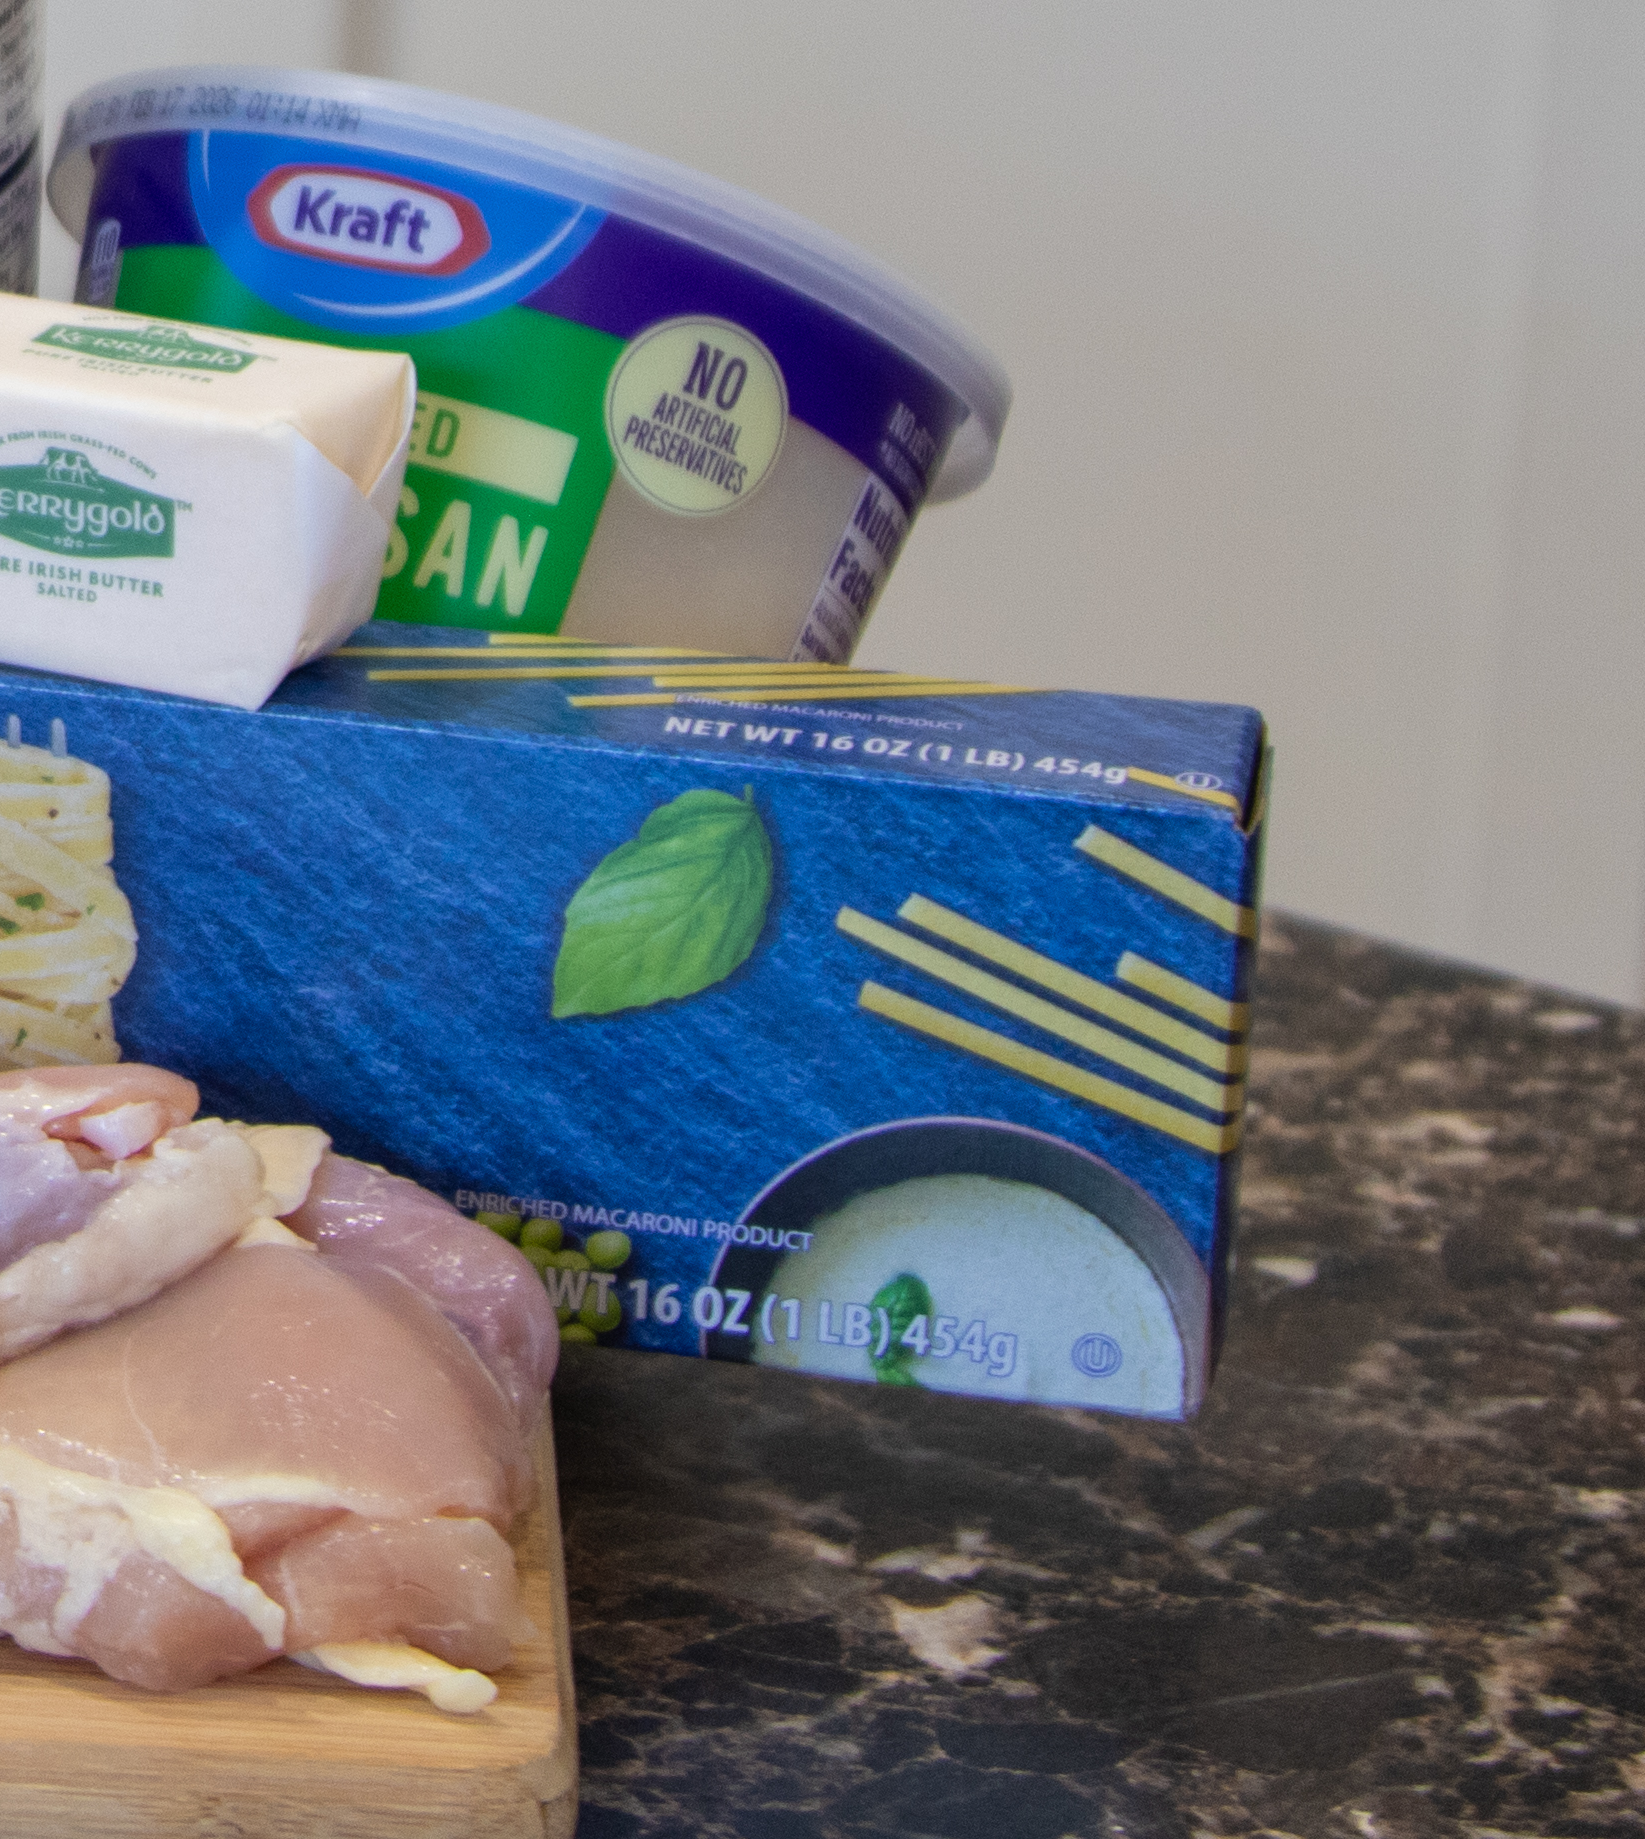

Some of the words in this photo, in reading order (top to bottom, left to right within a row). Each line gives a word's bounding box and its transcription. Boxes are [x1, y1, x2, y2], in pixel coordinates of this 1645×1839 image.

[292, 186, 431, 255] Kraft
[682, 341, 748, 412] NO
[7, 430, 36, 443] FROM
[37, 430, 68, 441] IRISH
[623, 414, 749, 496] PRESERVATIVES
[652, 391, 743, 457] ARTIFICIAL
[28, 560, 82, 584] IRISH
[88, 570, 165, 598] BUTTER
[37, 581, 98, 604] SALTED
[665, 716, 738, 740] NET
[742, 723, 803, 747] WT
[813, 732, 855, 751] 16
[863, 737, 913, 758] OZ
[919, 742, 954, 763] (1
[965, 746, 1026, 772] LB)
[1034, 756, 1129, 785] 454g
[771, 703, 874, 722] MACARONI
[876, 713, 966, 732] PRODUCT
[455, 1189, 568, 1220] ENRICHED
[573, 1203, 698, 1238] MACARONI
[702, 1220, 815, 1252] PRODUCT
[546, 1266, 617, 1316] WT
[629, 1279, 682, 1325] 16
[692, 1285, 752, 1335] OZ
[761, 1293, 802, 1345] (1
[817, 1301, 891, 1358] LB)
[900, 1314, 1019, 1378] 454g
